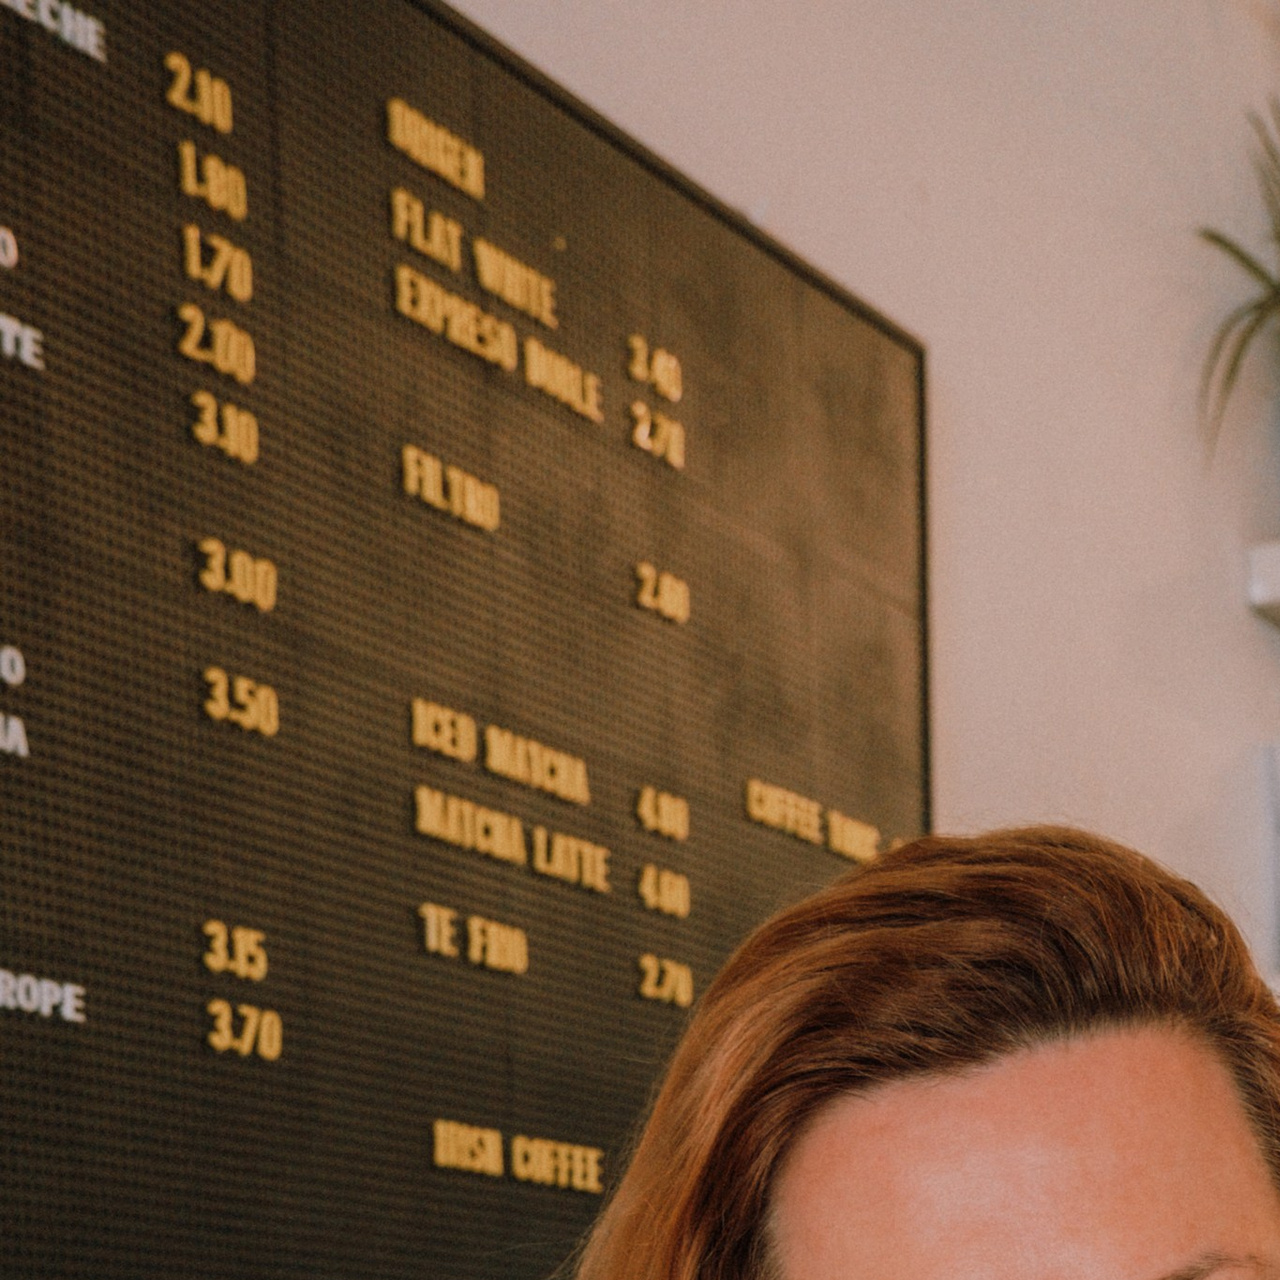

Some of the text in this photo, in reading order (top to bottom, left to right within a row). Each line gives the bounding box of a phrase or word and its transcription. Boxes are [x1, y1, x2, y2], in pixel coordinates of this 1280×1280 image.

[183, 224, 252, 300] 1.70
[391, 187, 559, 328] FLAT WHITE
[203, 667, 279, 737] 3.50
[414, 785, 612, 893] MATCHA LATTE
[202, 919, 268, 981] 3.15
[206, 999, 283, 1061] 3.70
[511, 1134, 604, 1193] COFFEE
